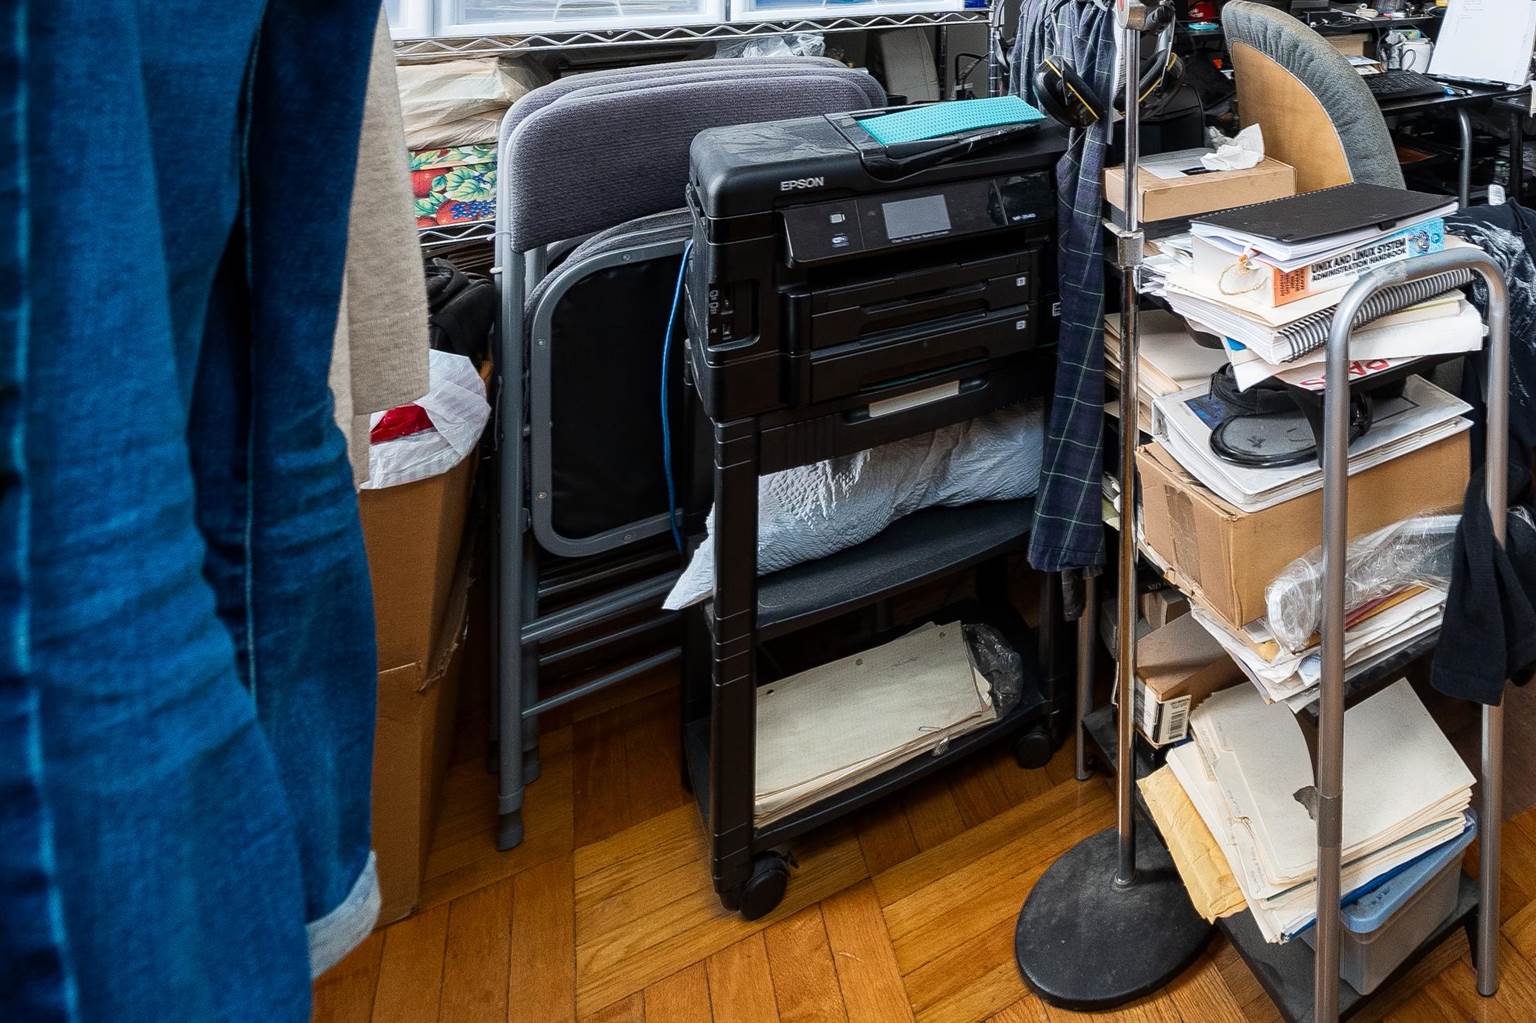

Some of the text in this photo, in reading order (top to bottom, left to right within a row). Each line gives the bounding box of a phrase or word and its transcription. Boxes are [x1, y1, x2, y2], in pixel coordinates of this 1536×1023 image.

[780, 176, 825, 192] EPSON
[1311, 261, 1334, 274] UNIX
[1333, 254, 1352, 267] AND
[1352, 246, 1377, 262] LINUX
[1377, 237, 1407, 254] SYSTEM
[1312, 248, 1407, 281] ADMINISTRATION HANDBOOK
